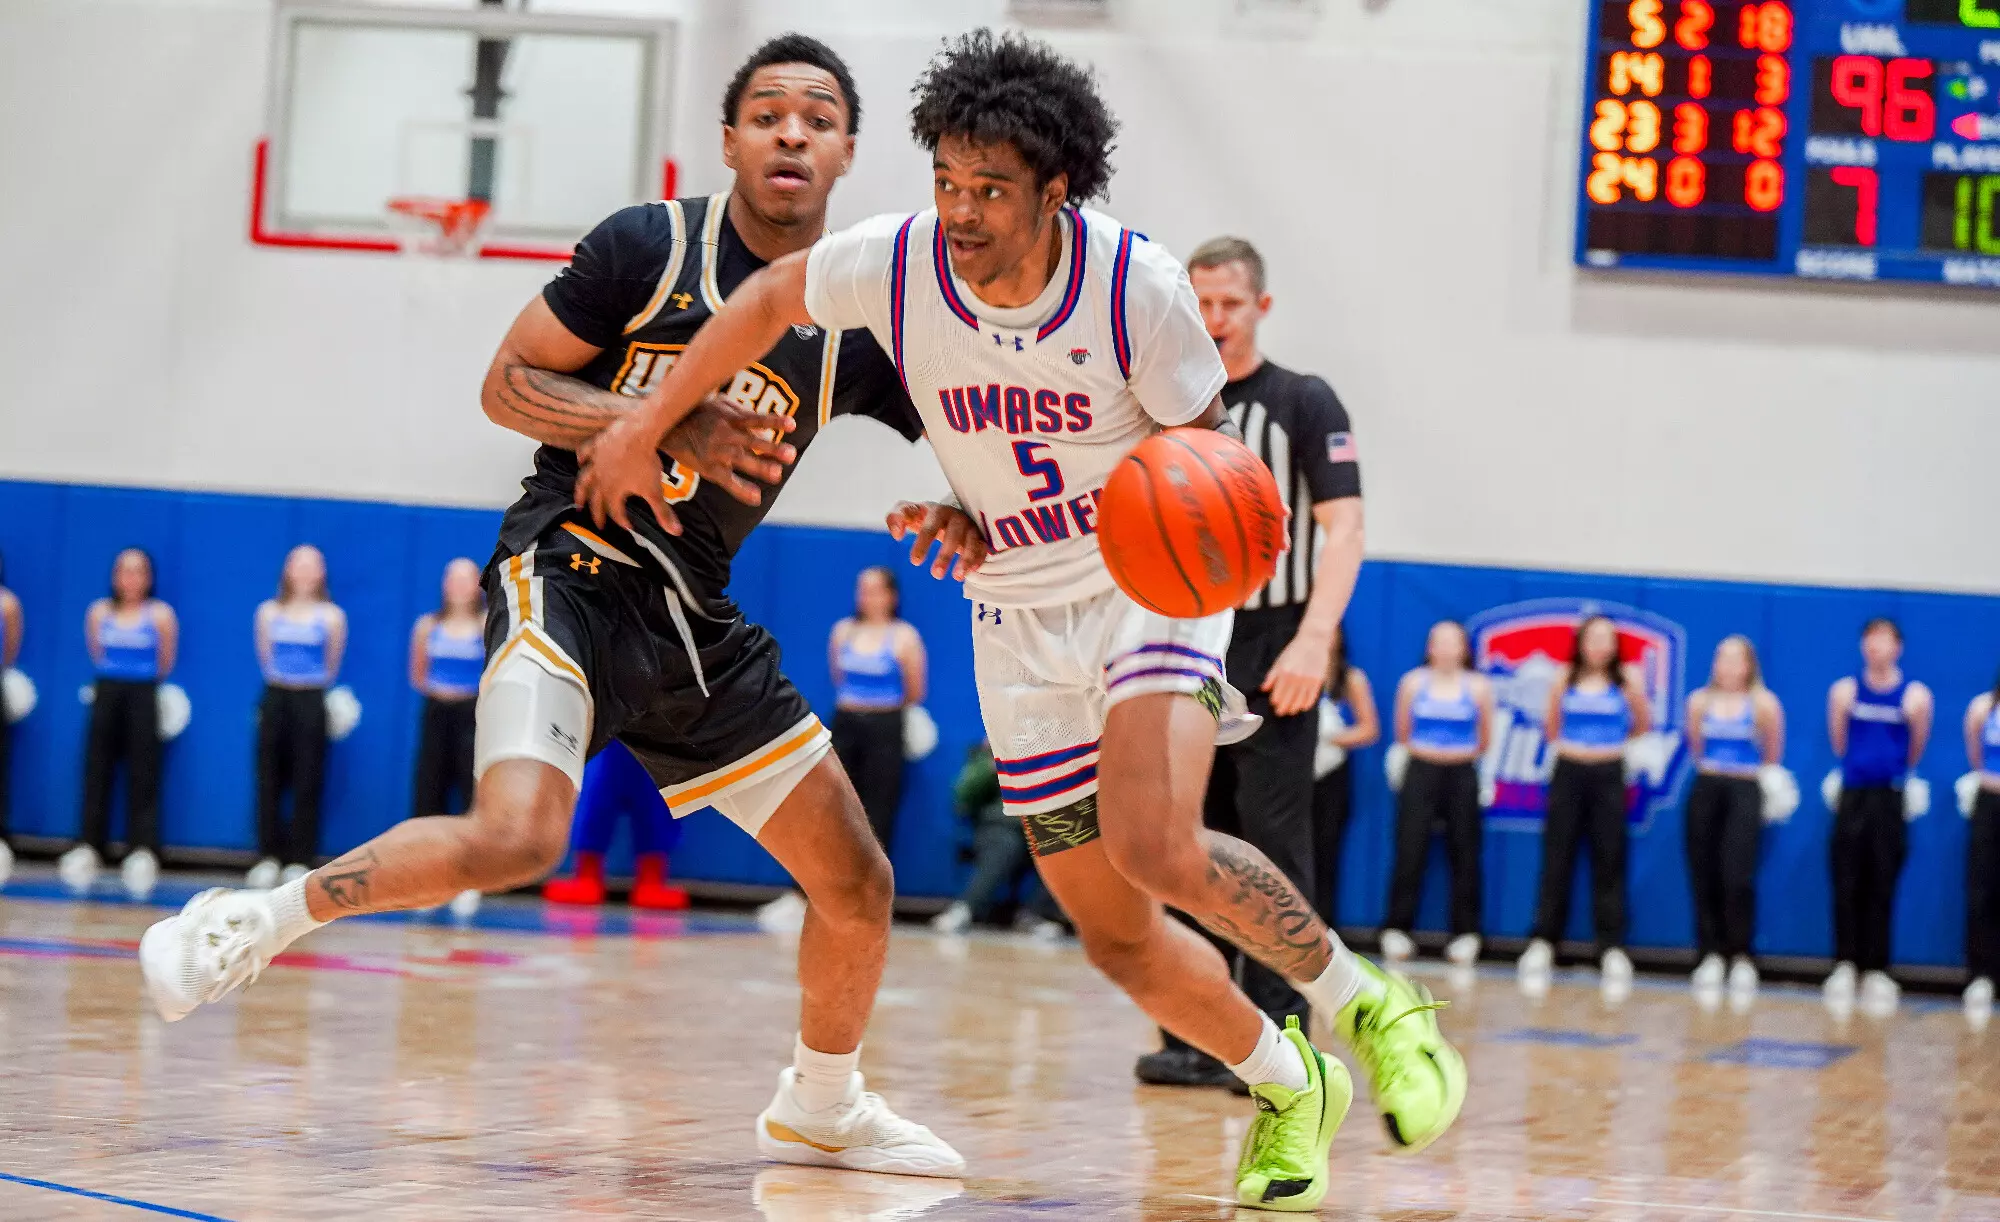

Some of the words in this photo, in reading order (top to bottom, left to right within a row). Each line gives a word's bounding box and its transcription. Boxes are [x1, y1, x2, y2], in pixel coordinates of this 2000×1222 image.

[1629, 0, 1666, 48] 5
[1675, 0, 1715, 50] 2
[1739, 1, 1793, 53] 18
[1610, 51, 1664, 96] 14
[1689, 54, 1711, 99] 1
[1755, 53, 1790, 106] 3
[1831, 55, 1936, 142] 96
[1590, 99, 1661, 153] 23
[1673, 102, 1709, 155] 3
[1733, 106, 1787, 159] 12
[1587, 151, 1658, 204] 24
[1665, 154, 1705, 208] 0
[1745, 158, 1784, 212] 0
[1830, 166, 1879, 247] 7
[938, 384, 1093, 435] UMASS
[1011, 440, 1065, 502] 5
